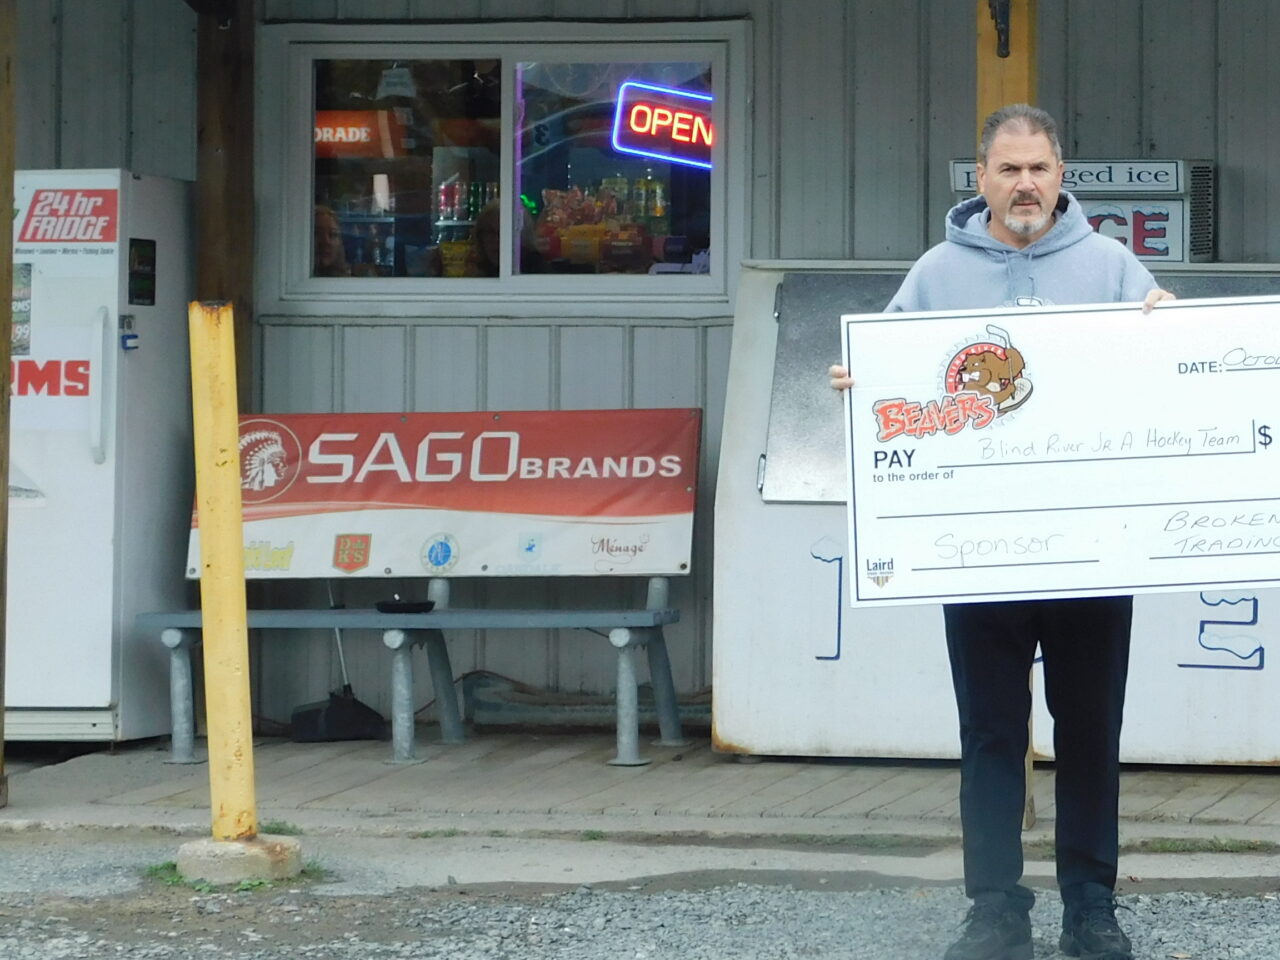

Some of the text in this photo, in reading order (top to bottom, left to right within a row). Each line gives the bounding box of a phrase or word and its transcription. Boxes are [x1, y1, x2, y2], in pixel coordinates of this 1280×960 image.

[629, 104, 713, 146] OPEN
[1127, 167, 1170, 183] ice
[33, 191, 104, 216] 24 hr
[24, 216, 110, 241] FRIDGE
[1086, 204, 1170, 257] CE
[1178, 361, 1223, 374] DATE:
[873, 391, 995, 443] BEAVERS
[306, 431, 683, 484] SAGO BRANDS
[873, 449, 916, 469] PAY
[979, 436, 1036, 460] Blind
[1046, 433, 1082, 455] River
[1120, 432, 1134, 451] A
[1147, 428, 1192, 455] Hockey
[1198, 426, 1240, 447] Team
[1257, 424, 1273, 449] $
[873, 469, 954, 483] to the order of
[591, 536, 645, 558] Ménage
[934, 533, 1066, 568] Sponsor
[866, 557, 894, 571] Laird
